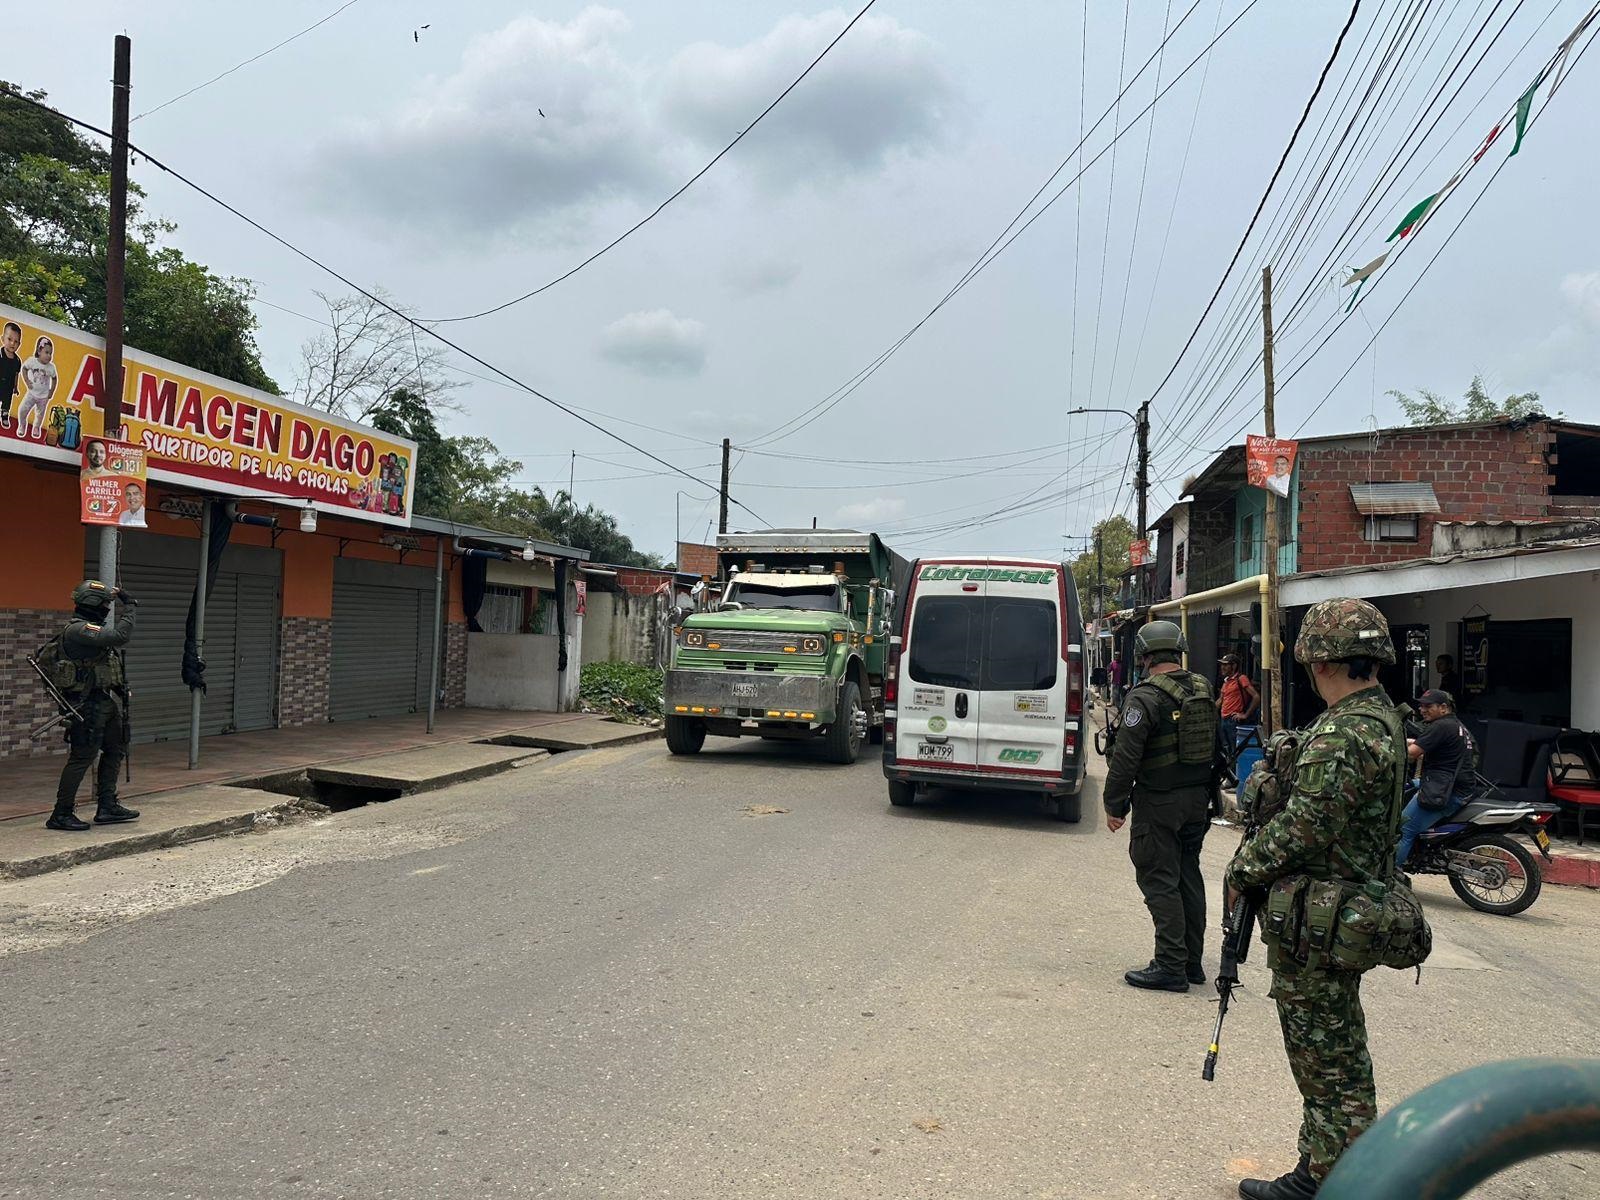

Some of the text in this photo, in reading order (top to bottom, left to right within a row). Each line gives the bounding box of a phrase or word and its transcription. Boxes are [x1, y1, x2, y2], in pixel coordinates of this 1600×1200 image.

[70, 354, 375, 478] ALMACEN DAGO
[108, 444, 143, 457] Diógenes
[125, 460, 140, 473] 101
[140, 429, 234, 468] SURTIDOR
[240, 453, 262, 475] DE
[266, 458, 293, 482] LAS
[298, 467, 350, 495] CHOLAS
[89, 479, 118, 488] WILMER
[85, 486, 121, 496] CARRILLO
[106, 500, 117, 513] 7
[919, 565, 1056, 584] Cotranscat
